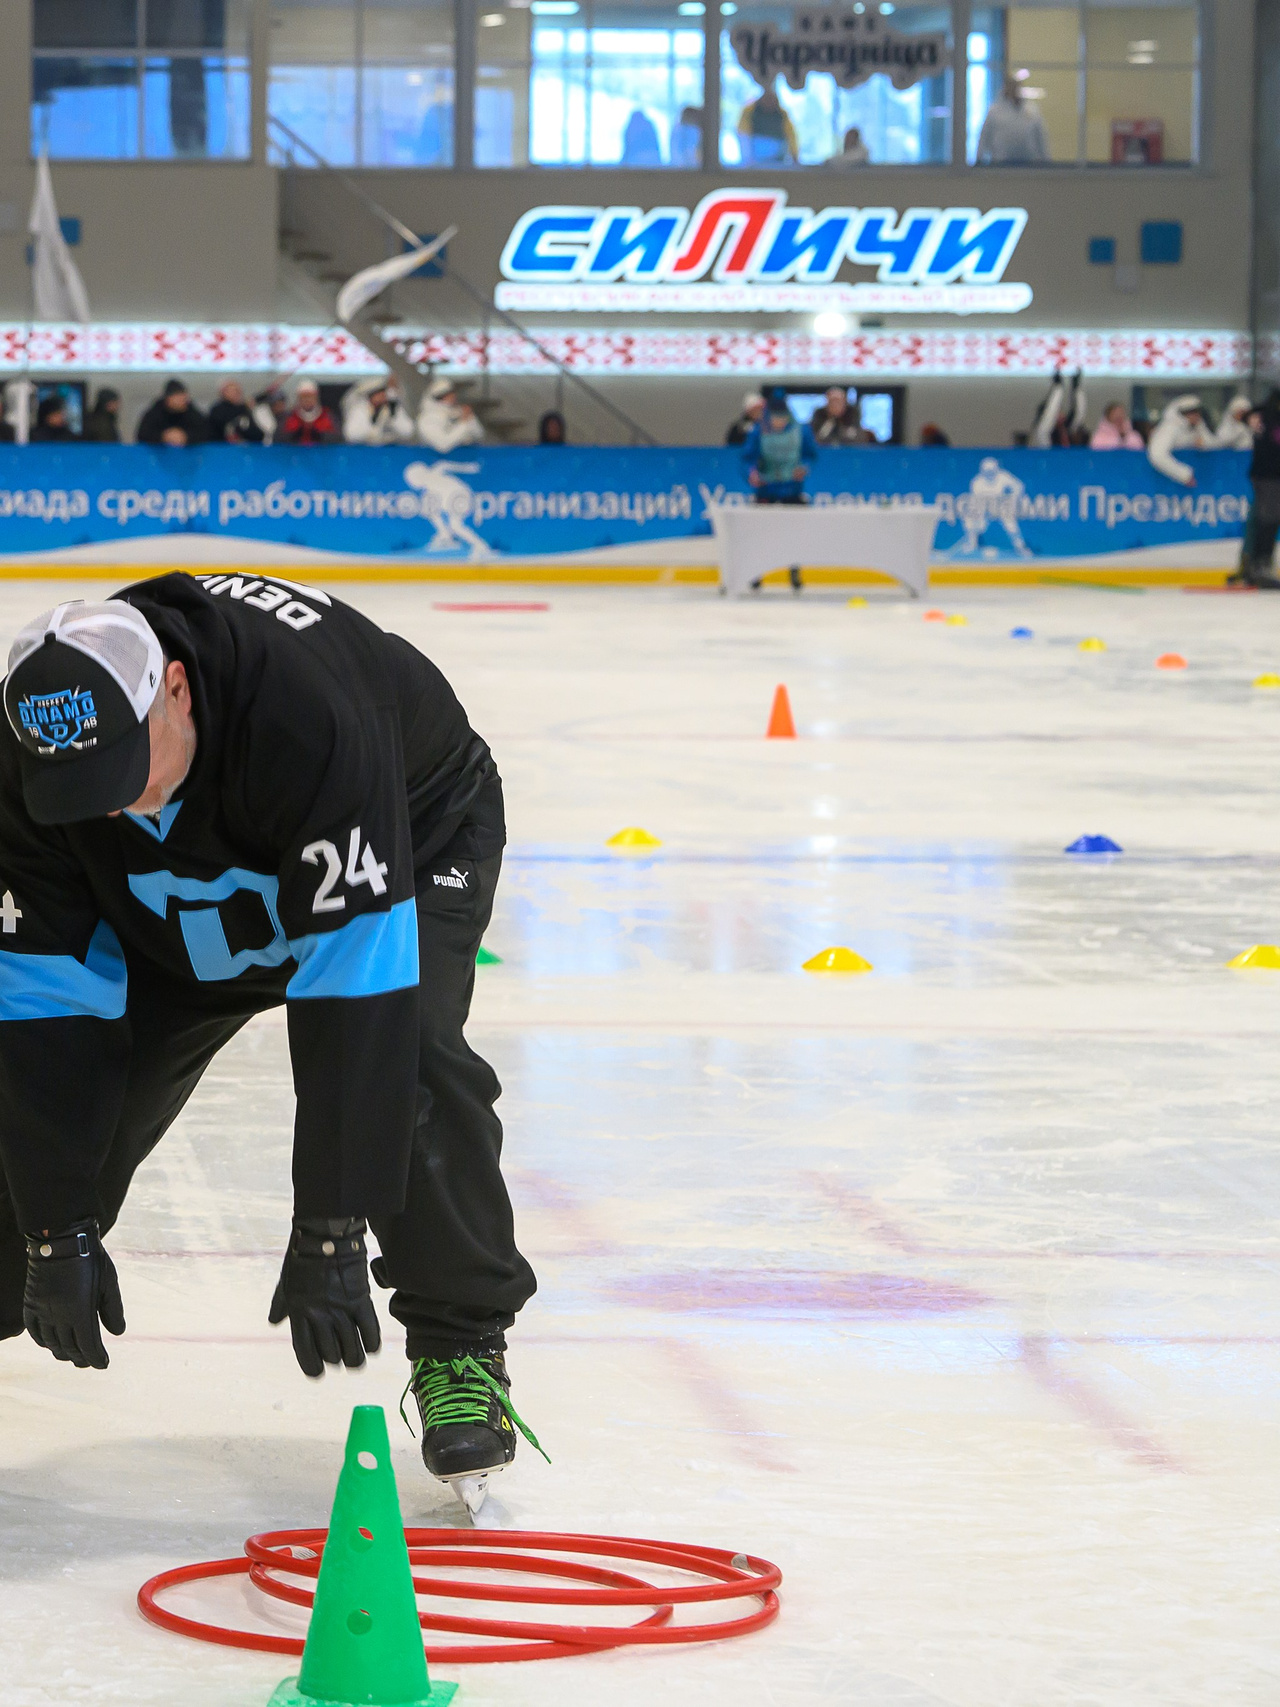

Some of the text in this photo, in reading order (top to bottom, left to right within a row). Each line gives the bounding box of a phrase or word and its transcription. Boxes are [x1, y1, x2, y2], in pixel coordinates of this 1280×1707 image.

[97, 489, 210, 525] среди
[19, 697, 95, 725] DINAMO
[301, 826, 389, 914] 24
[433, 874, 463, 889] PUMA
